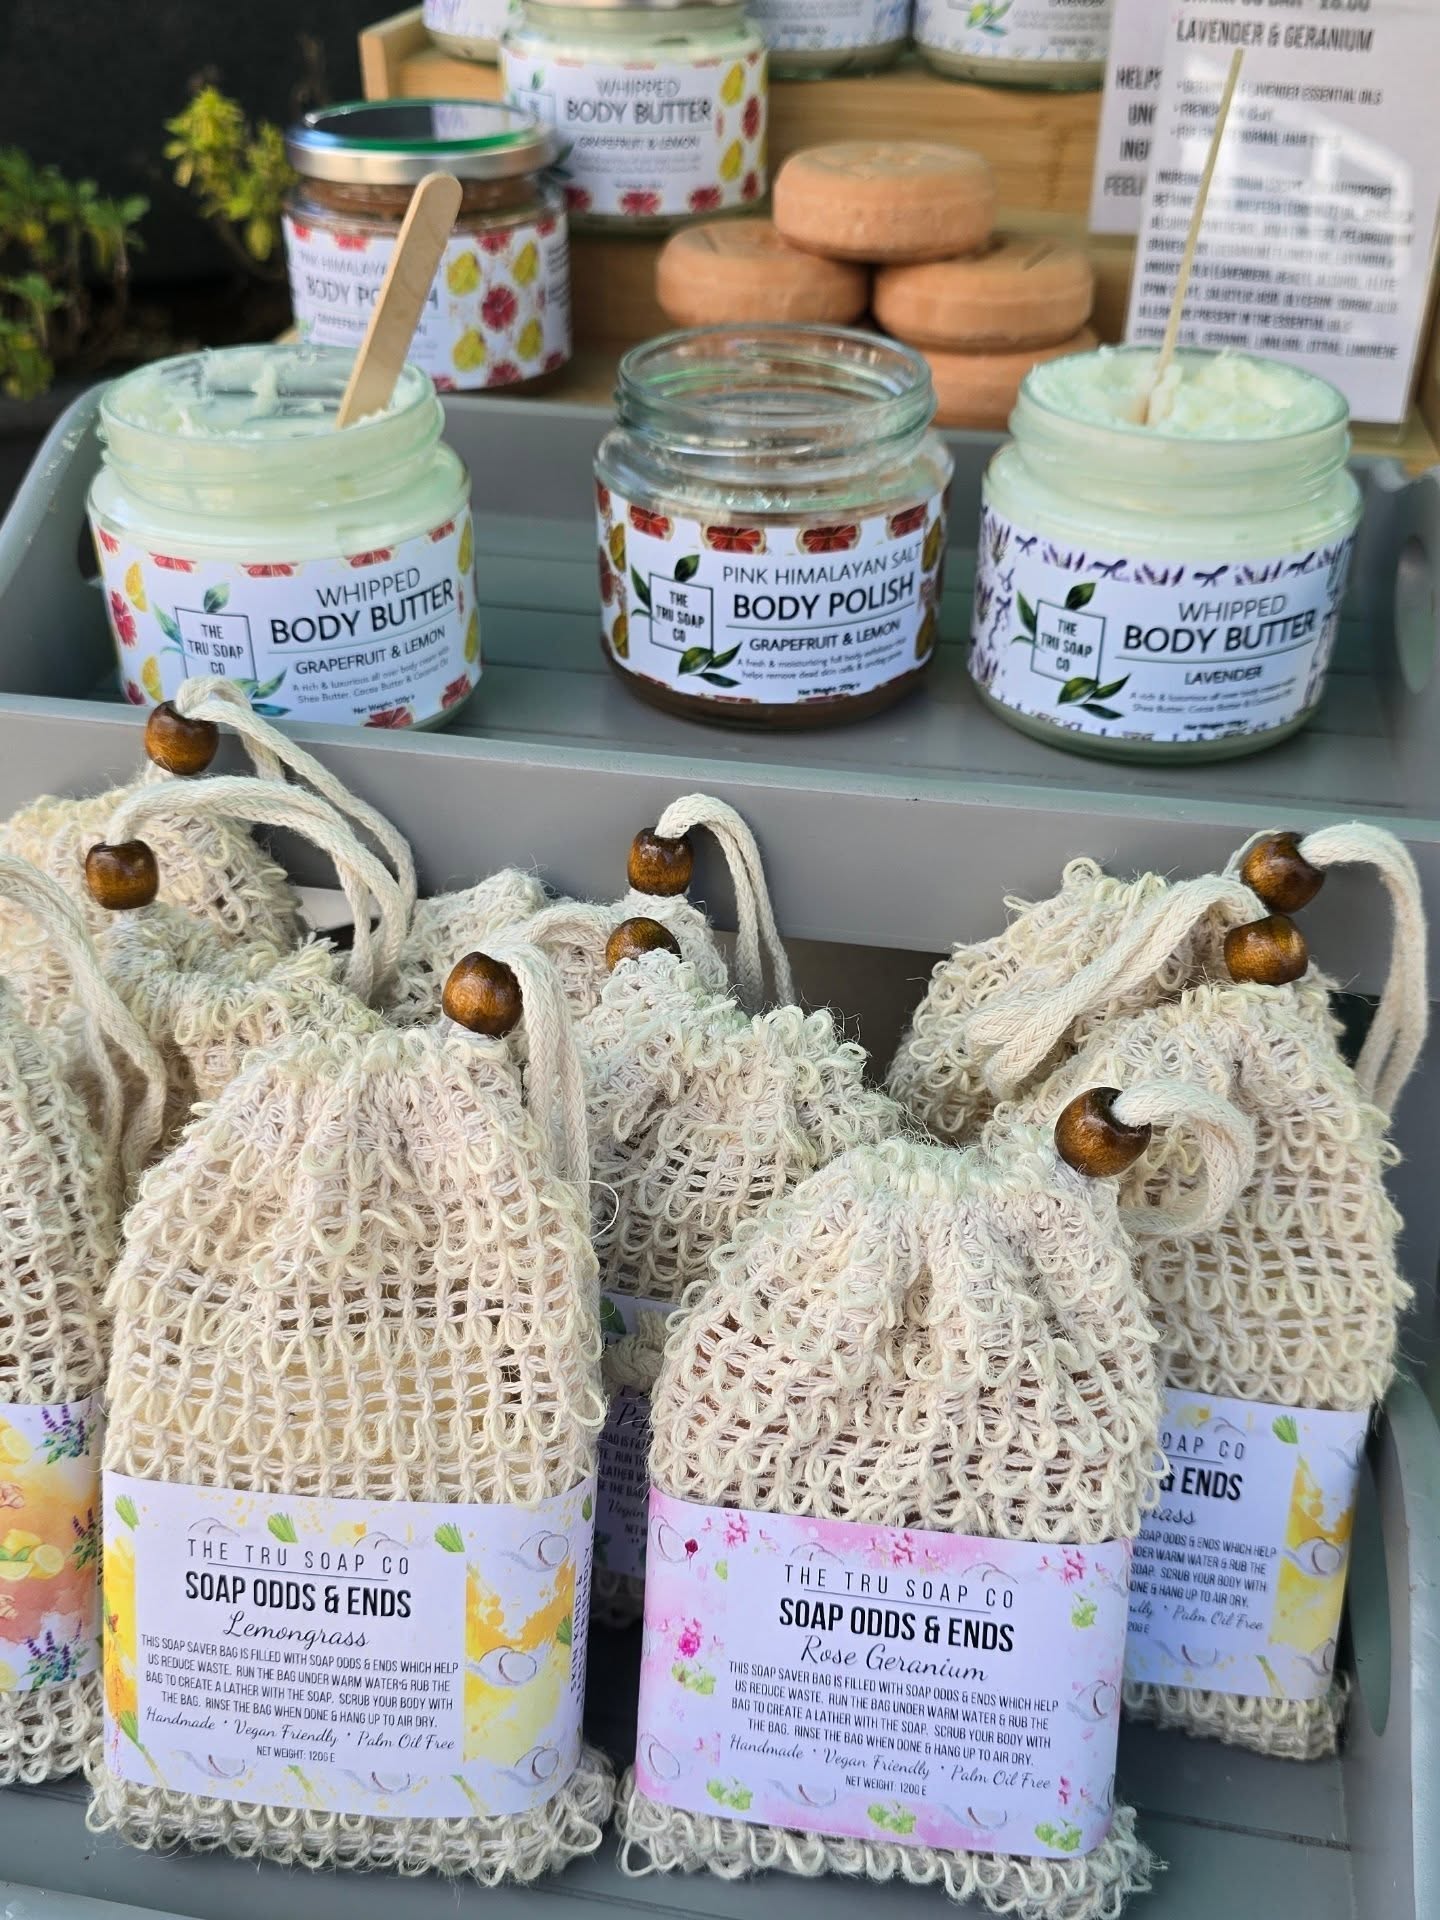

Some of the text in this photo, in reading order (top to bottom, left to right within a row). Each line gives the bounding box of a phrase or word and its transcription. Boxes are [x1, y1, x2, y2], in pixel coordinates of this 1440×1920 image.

[567, 100, 712, 124] BODY BUTTER
[723, 542, 921, 586] PINK HIMALAYAN SALT
[316, 567, 421, 608] WHIPPED
[670, 591, 688, 606] THE
[734, 571, 914, 620] BODY POLISH
[270, 577, 454, 644] BODY BUTTER
[655, 604, 704, 630] TRU SOAP
[1179, 595, 1287, 623] WHIPPED
[200, 624, 224, 639] THE
[672, 628, 686, 643] CO
[749, 634, 838, 651] GRAPEFRUIT
[842, 632, 853, 646] &
[856, 620, 901, 645] LEMON
[1041, 632, 1093, 658] TRU SOAP
[1058, 619, 1077, 637] THE
[1124, 608, 1316, 653] BODY BUTTER
[187, 640, 243, 659] TRU SOAP
[296, 626, 445, 675] GRAPEFRUIT & LEMON
[1056, 657, 1070, 672] CO
[210, 661, 225, 675] CO
[1185, 664, 1263, 685] LAVENDER
[1219, 1440, 1244, 1460] CO
[1181, 1466, 1243, 1501] ENDS
[188, 1538, 408, 1574] THE TRU SOAP CO
[186, 1572, 411, 1617] SOAP ODDS & ENDS
[785, 1565, 1012, 1608] THE TRU SOAP CO
[223, 1610, 369, 1650] Lemongrass
[779, 1597, 1014, 1652] SOAP ODDS & ENDS
[142, 1635, 458, 1674] THIS SOAP SAVER BAG IS FILLED WITH SOAP ODDS & ENDS WHICH HELP
[801, 1635, 988, 1682] Rose Geranium
[146, 1671, 452, 1710] BAG TO CREATE A LATHER WITH THE SOAP. SCRUB YOUR BODY WITH
[148, 1654, 449, 1692] US REDUCE WASTE. RUN THE BAG UNDER WARM WATER & RUB THE
[161, 1691, 437, 1728] THE BAG. RINSE THE BAG WHEN DONE & HANG UP TO AIR DRY.
[147, 1706, 454, 1750] Handmade Vegan Friendly Palm Oil Free
[256, 1745, 271, 1756] NET
[273, 1747, 305, 1759] WEIGHT:
[330, 1752, 334, 1762] E
[730, 1733, 1050, 1789] Handmade Vegan Friendly Palm Oil Free
